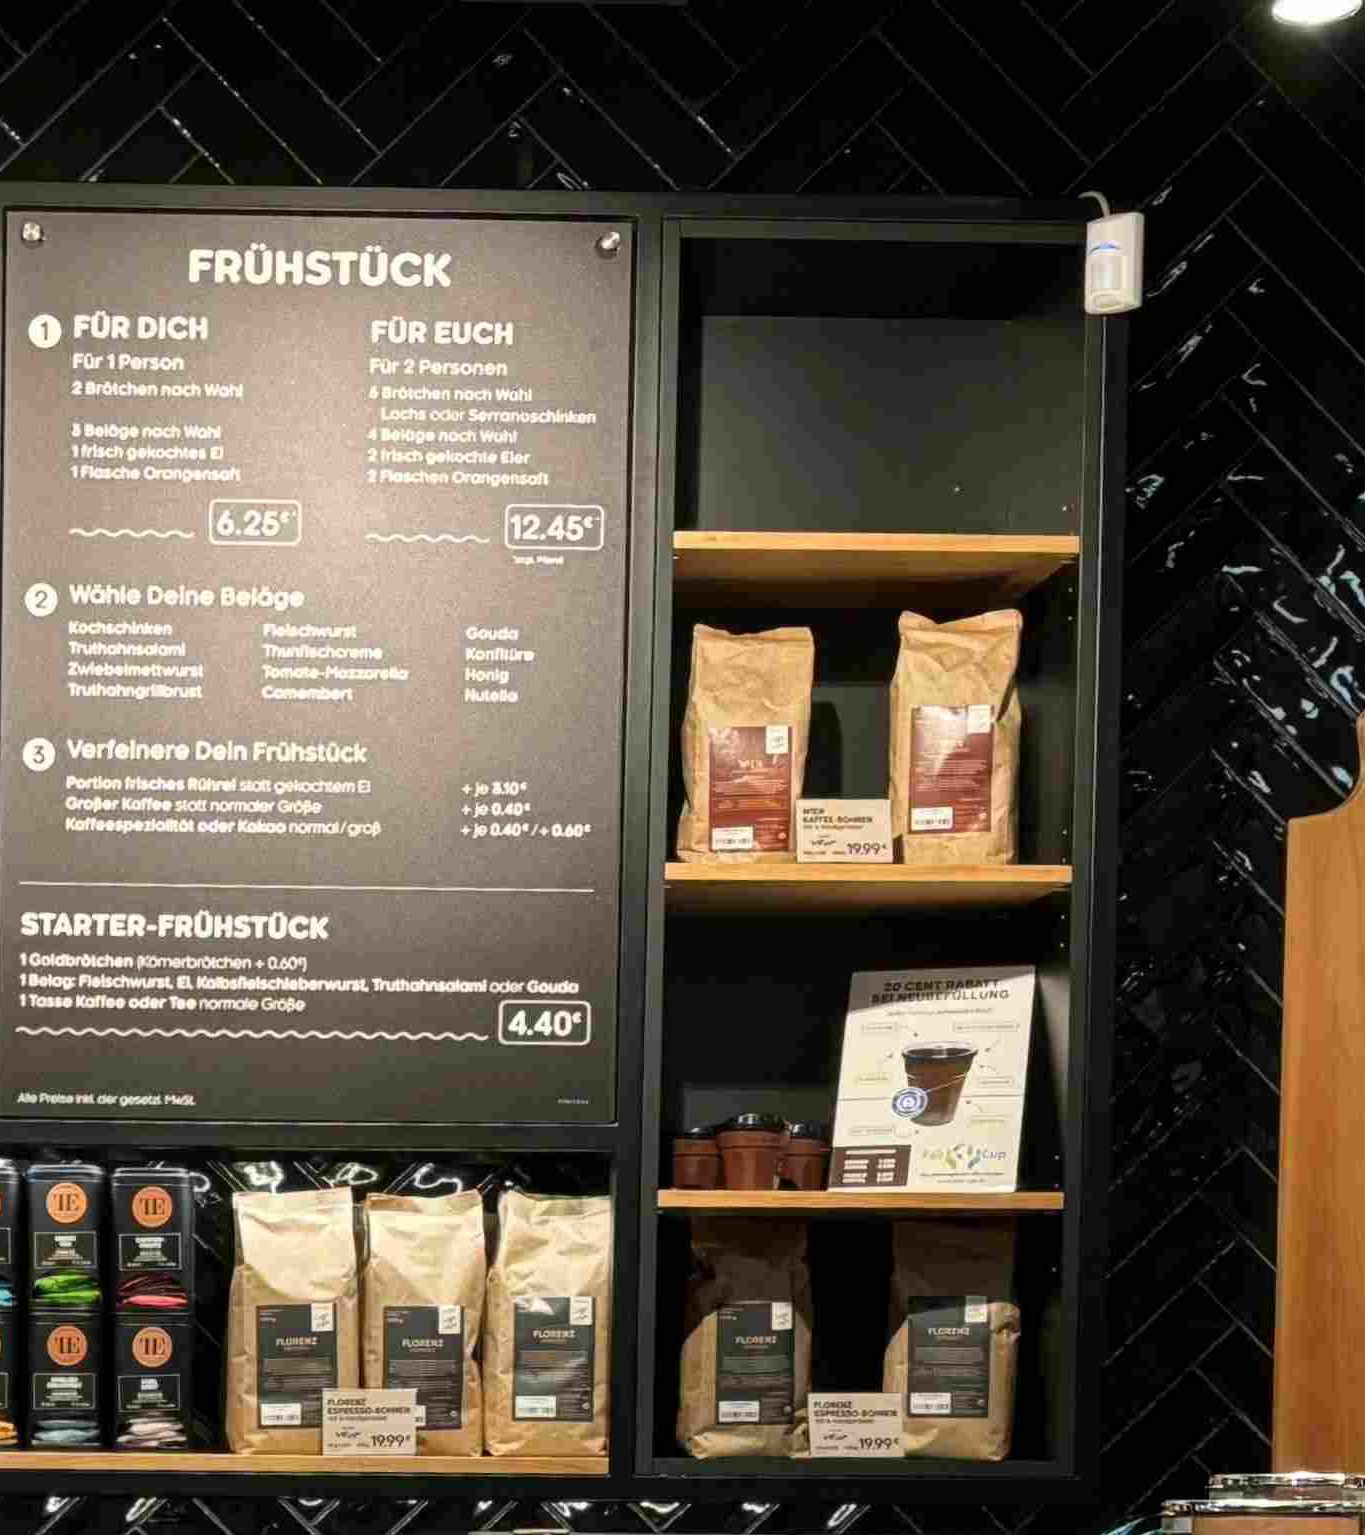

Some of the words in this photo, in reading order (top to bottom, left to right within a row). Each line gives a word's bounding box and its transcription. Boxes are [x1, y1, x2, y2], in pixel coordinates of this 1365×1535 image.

[188, 244, 452, 288] FRÜHSTÜCK
[73, 313, 132, 340] FÜR
[138, 315, 209, 340] DICH
[371, 319, 427, 345] FÜR
[434, 322, 514, 346] EUCH
[72, 352, 104, 371] Für
[107, 354, 115, 371] 1
[118, 354, 184, 372] Person
[370, 357, 400, 375] Für
[403, 359, 415, 375] 2
[419, 359, 508, 377] Personen
[69, 584, 142, 607] Wähle
[147, 586, 215, 608] Deine
[220, 586, 304, 611] Beläge
[466, 626, 518, 641] Gouda
[465, 666, 509, 685] Honig
[67, 740, 190, 762] Verfeinere
[195, 741, 248, 763] Dein
[253, 740, 367, 764] Frühstück
[20, 910, 329, 941] STARTER-FRÜHSTÜCK
